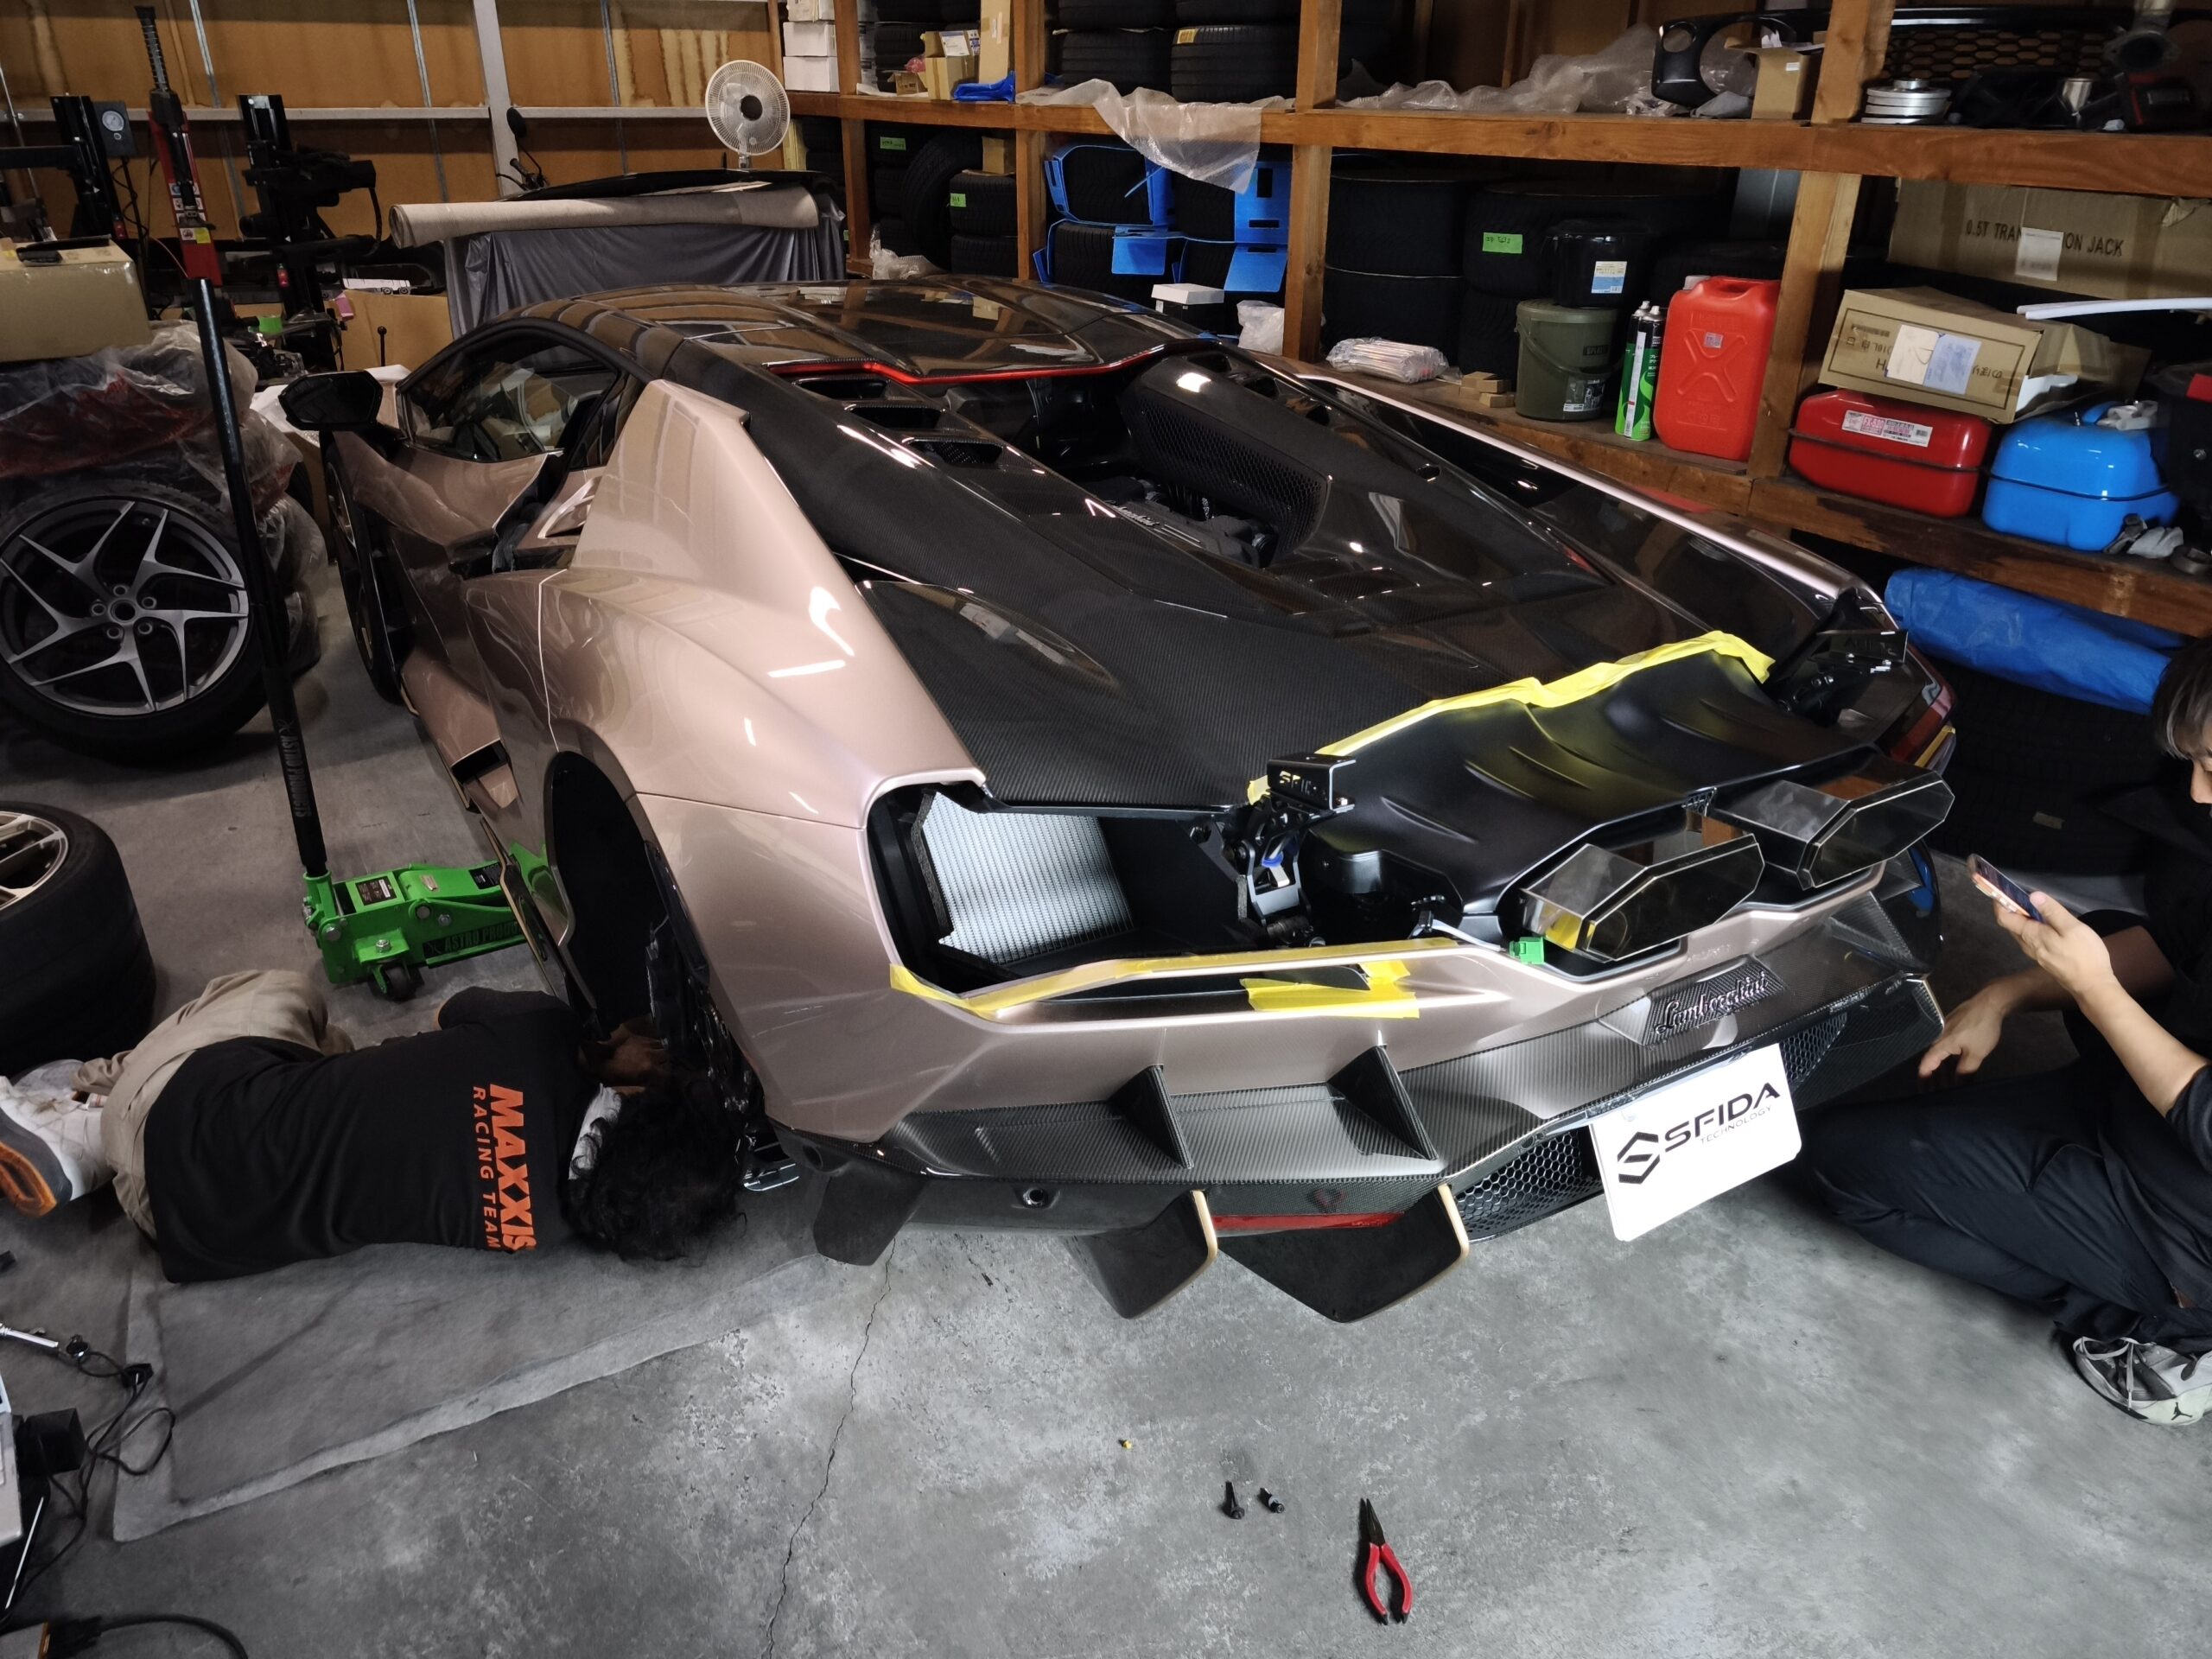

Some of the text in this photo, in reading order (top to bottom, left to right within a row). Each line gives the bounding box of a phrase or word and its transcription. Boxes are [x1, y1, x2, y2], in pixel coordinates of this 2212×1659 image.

[1966, 219, 1990, 237] 0.5T
[2087, 236, 2125, 257] JACK
[1654, 969, 1770, 1035] Lamborghini
[1664, 1082, 1781, 1153] SFIDA
[1700, 1105, 1772, 1145] TECHNOLOGY
[473, 1086, 501, 1249] RACING TEAM
[489, 1084, 537, 1251] MAXXIS
